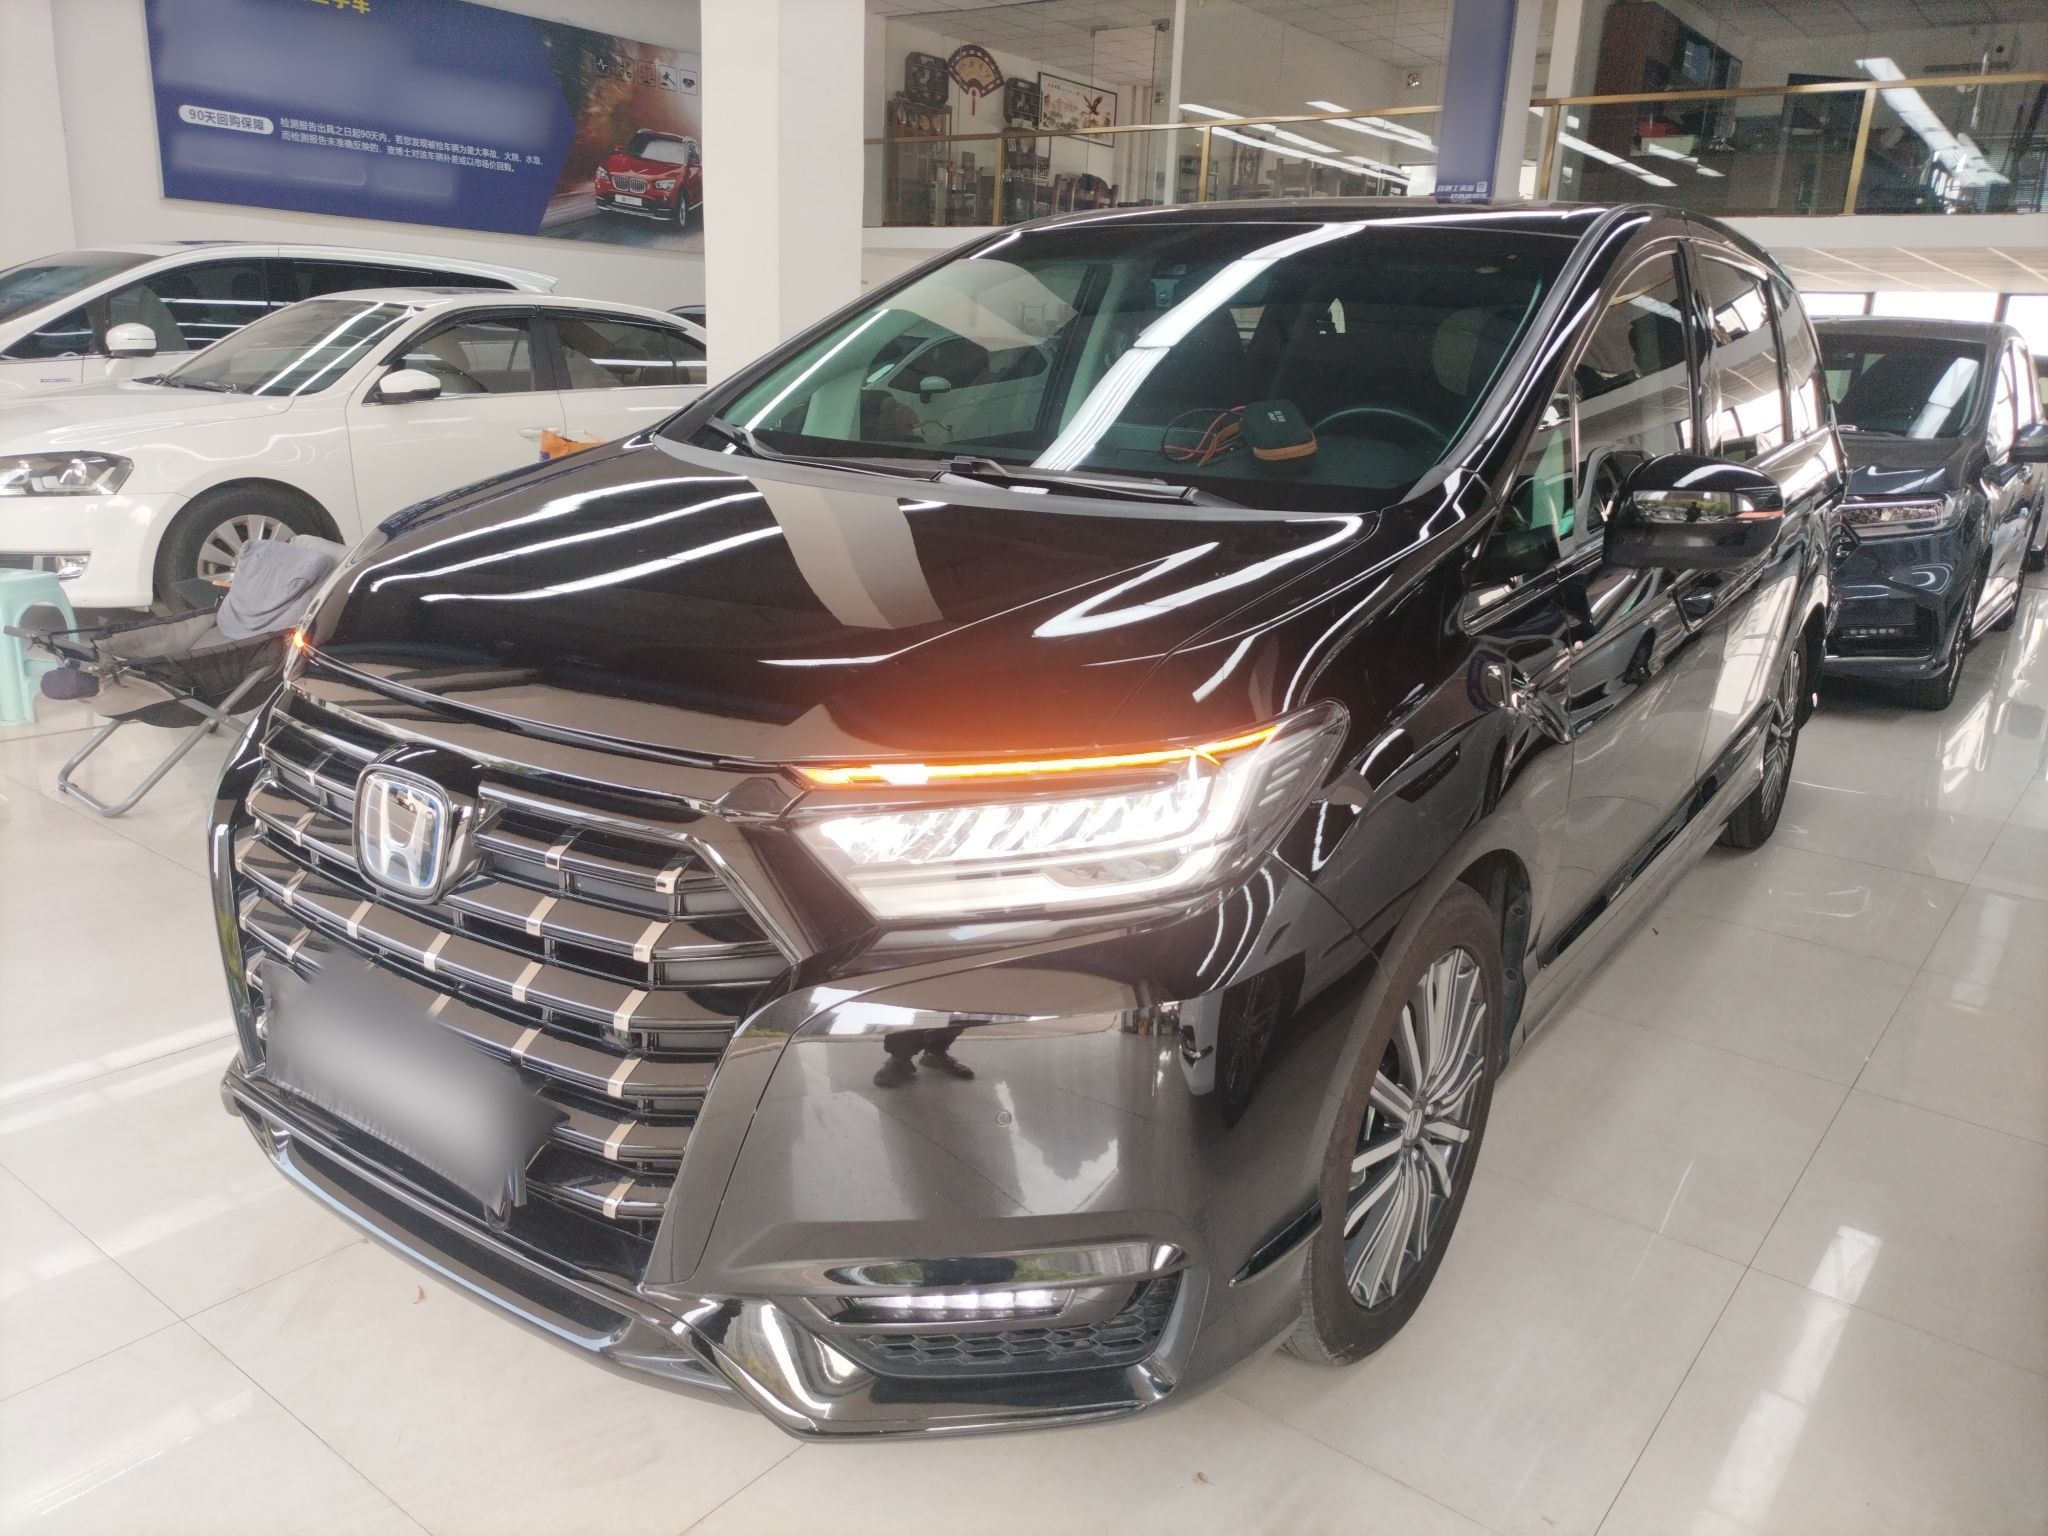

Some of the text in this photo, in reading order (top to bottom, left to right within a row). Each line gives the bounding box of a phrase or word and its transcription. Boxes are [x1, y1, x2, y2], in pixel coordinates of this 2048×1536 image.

[188, 107, 265, 132] 90天回购保障
